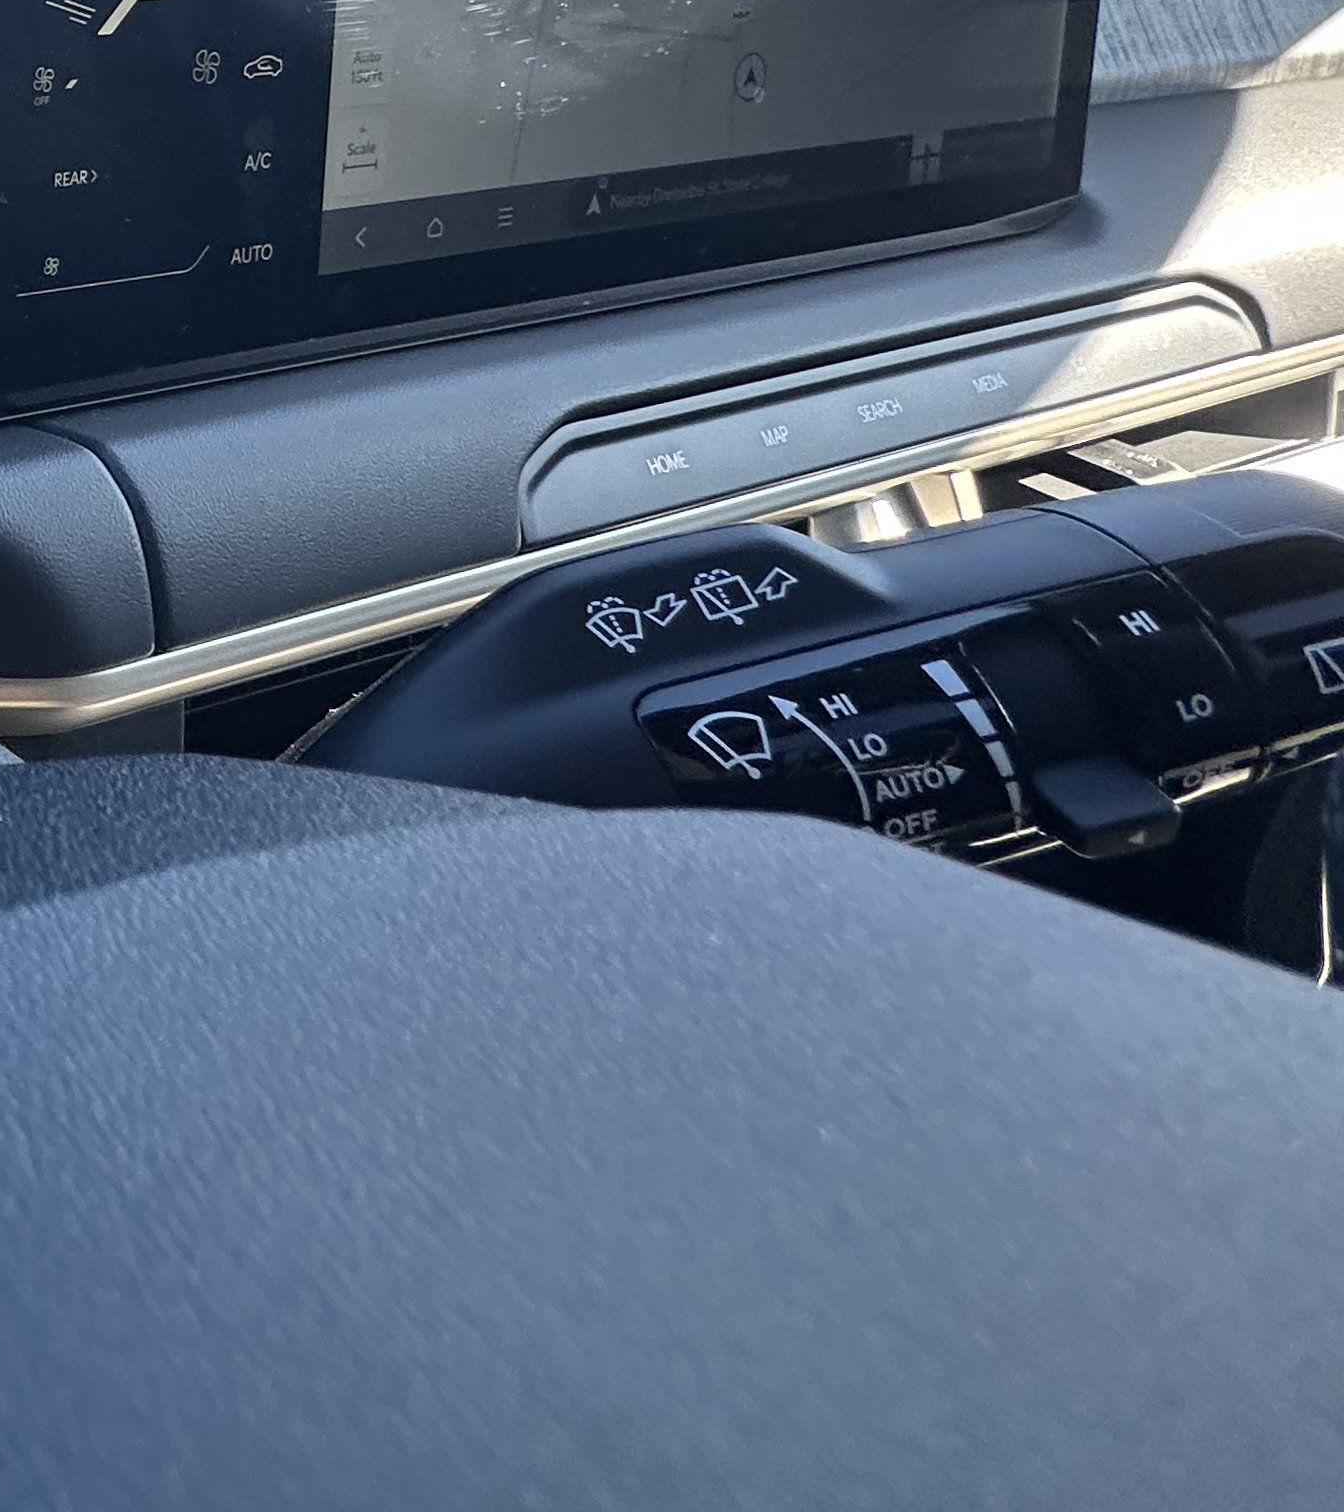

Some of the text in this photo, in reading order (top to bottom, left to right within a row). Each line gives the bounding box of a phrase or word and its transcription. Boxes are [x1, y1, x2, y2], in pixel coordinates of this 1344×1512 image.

[346, 139, 377, 157] Scale
[243, 151, 272, 172] A/C
[53, 169, 88, 189] REAR
[230, 243, 274, 266] AUTO
[971, 372, 1009, 394] MEDIA
[857, 398, 903, 424] SEARCH
[760, 425, 789, 448] MAP
[645, 450, 690, 476] HOME
[1119, 608, 1164, 638] HI
[818, 692, 859, 719] HI
[1175, 692, 1214, 723] LO
[847, 732, 888, 761] LO
[875, 766, 945, 803] AUTO
[883, 808, 938, 838] OFF
